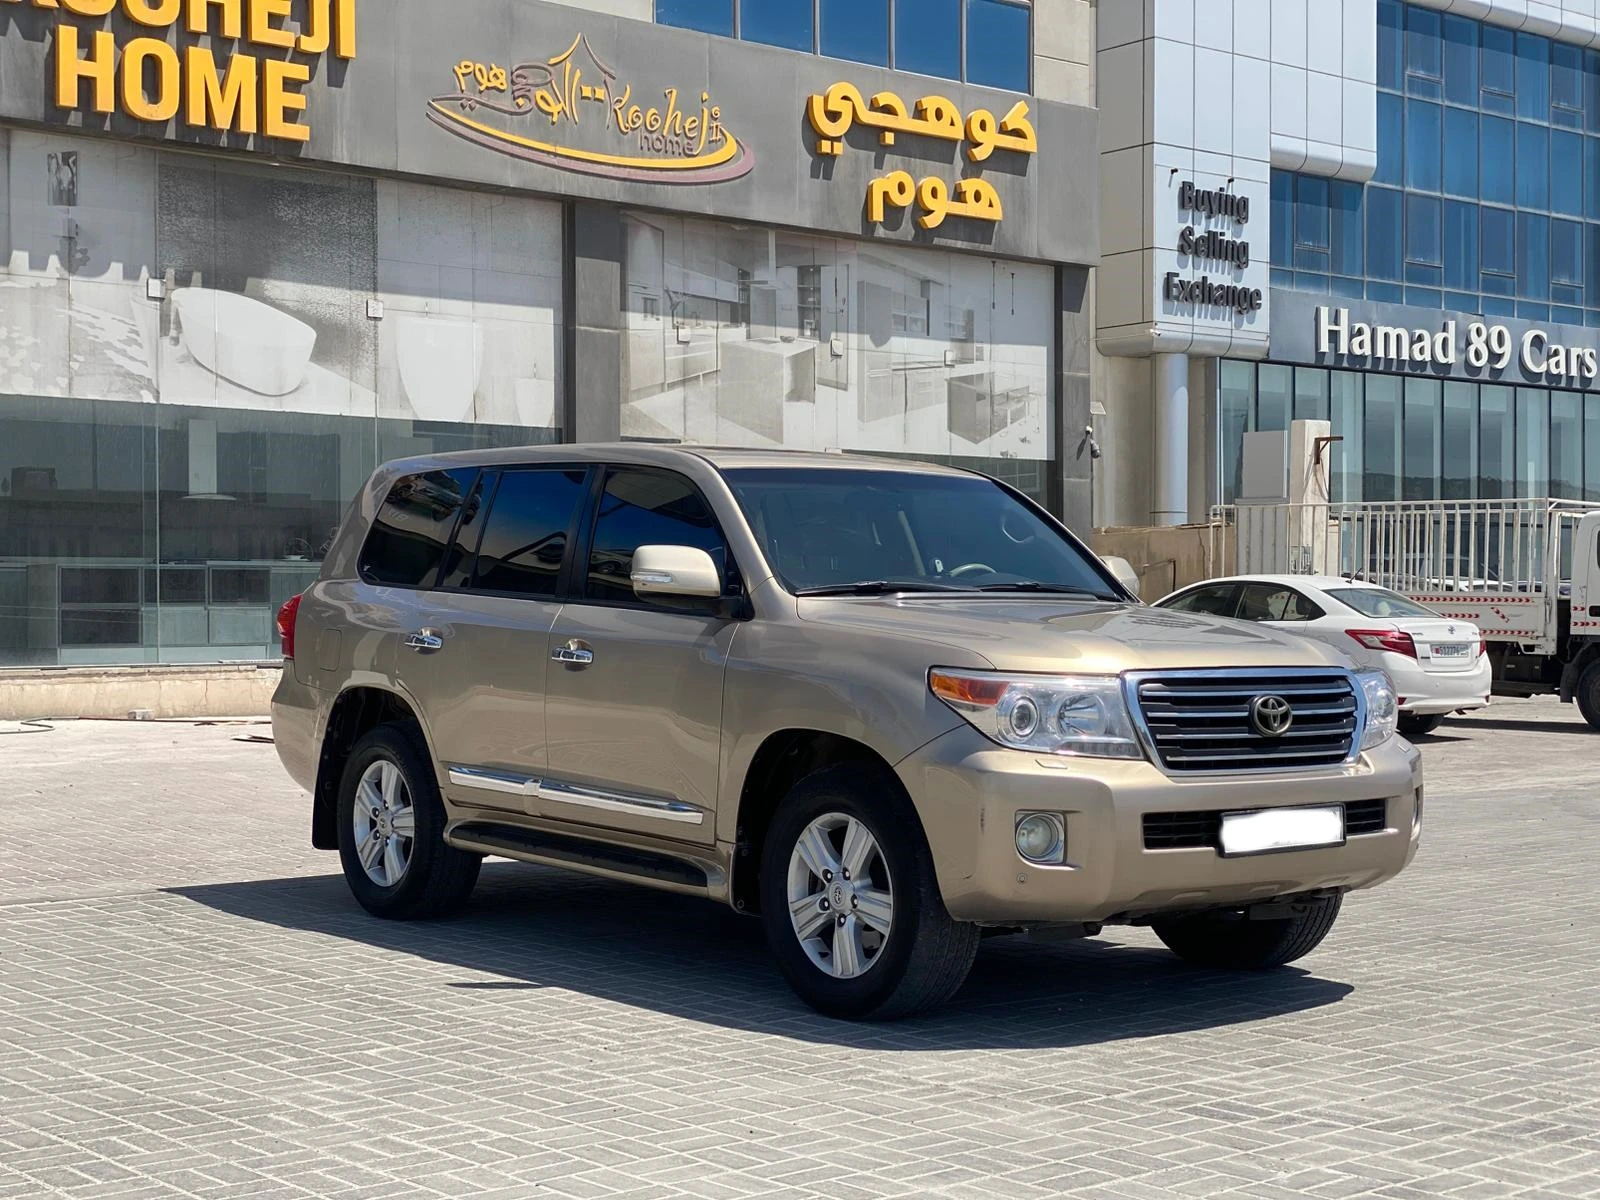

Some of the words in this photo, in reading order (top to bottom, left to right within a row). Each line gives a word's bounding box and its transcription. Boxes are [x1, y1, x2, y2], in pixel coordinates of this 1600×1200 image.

[0, 0, 357, 59] HEJI
[56, 24, 311, 142] HOME
[453, 60, 508, 93] هوم
[638, 131, 697, 157] home
[808, 81, 1038, 162] كوهجي
[867, 170, 1003, 229] هوم
[1180, 180, 1250, 225] Buying
[1177, 225, 1250, 269] Selling
[1163, 271, 1263, 316] Exchange
[1314, 305, 1457, 366] Hamad
[1466, 322, 1513, 370] 89
[1520, 328, 1599, 380] Cars
